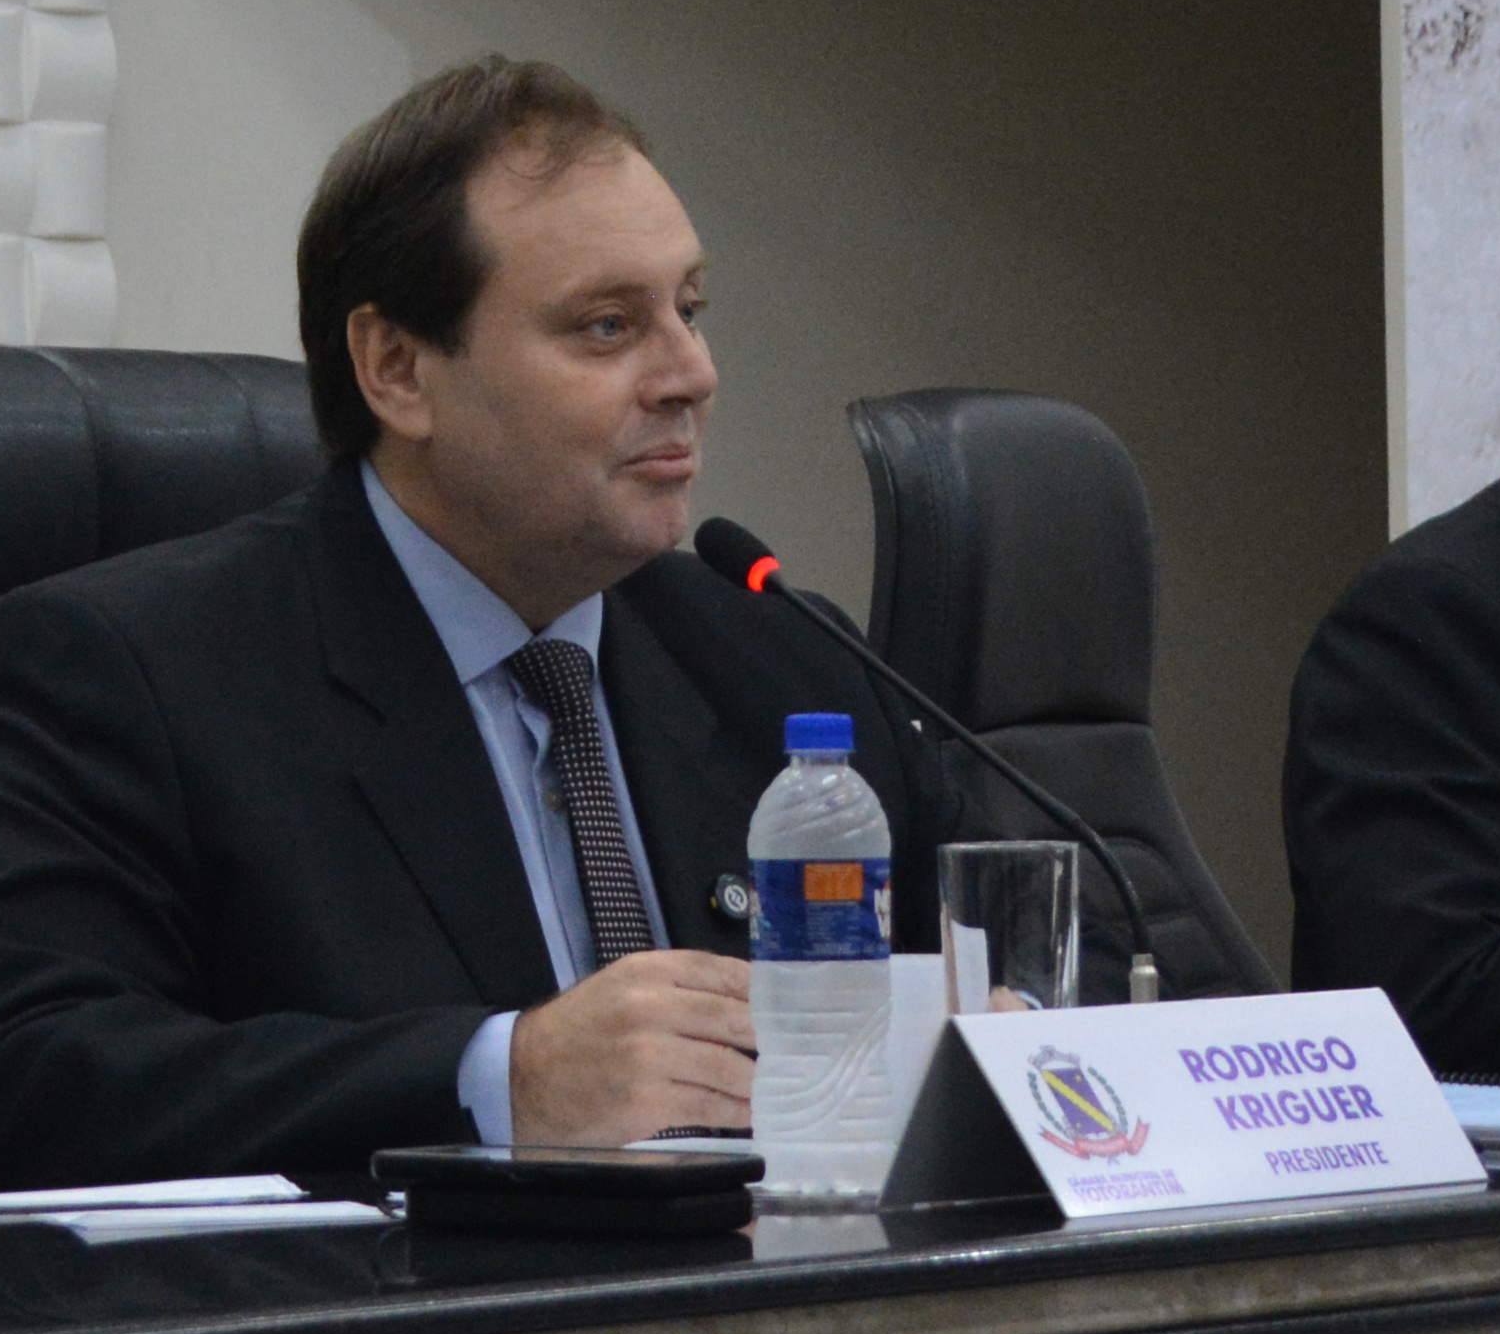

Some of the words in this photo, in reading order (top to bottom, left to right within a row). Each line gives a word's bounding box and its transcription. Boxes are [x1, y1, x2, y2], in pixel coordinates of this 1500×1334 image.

[1177, 1036, 1358, 1084] RODRIGO
[1213, 1084, 1383, 1131] KRIGUER
[1265, 1141, 1390, 1176] PRESIDENTE
[1073, 1179, 1185, 1203] VOTORANTIM
